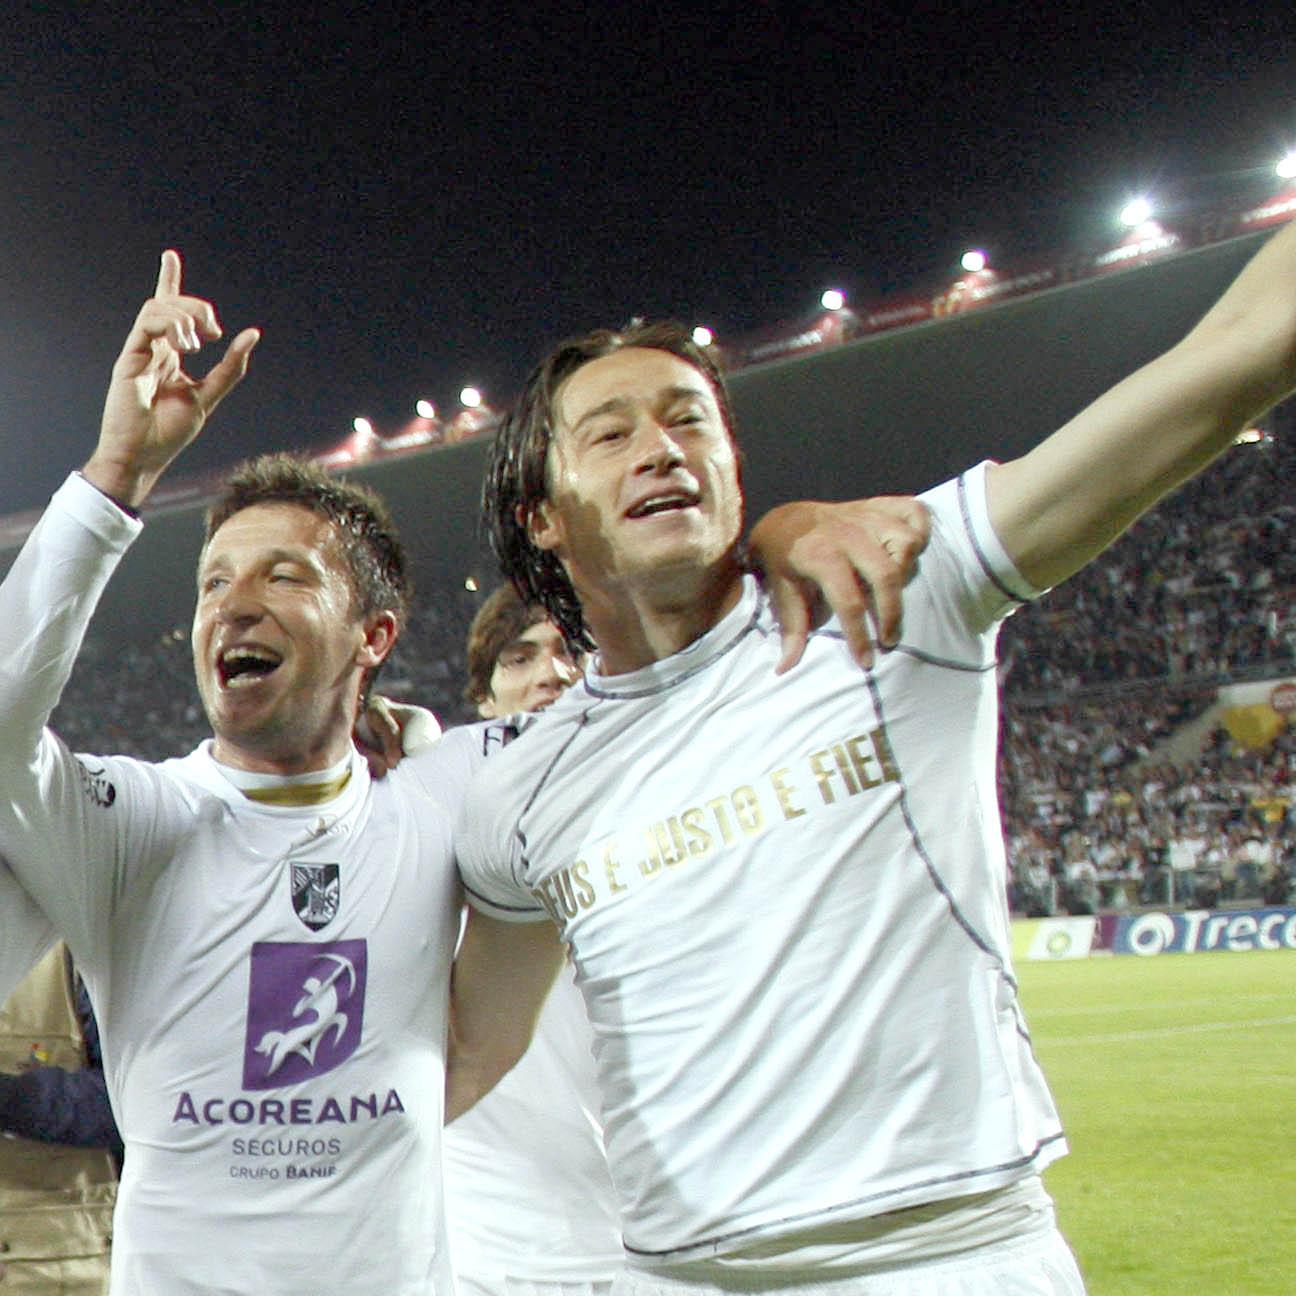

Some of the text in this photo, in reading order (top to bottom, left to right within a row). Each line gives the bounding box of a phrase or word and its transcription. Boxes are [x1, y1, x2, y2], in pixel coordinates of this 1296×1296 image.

[638, 784, 766, 878] JUSTO
[232, 1138, 341, 1156] SEGUROS
[230, 1165, 337, 1180] GRUPO BANIF
